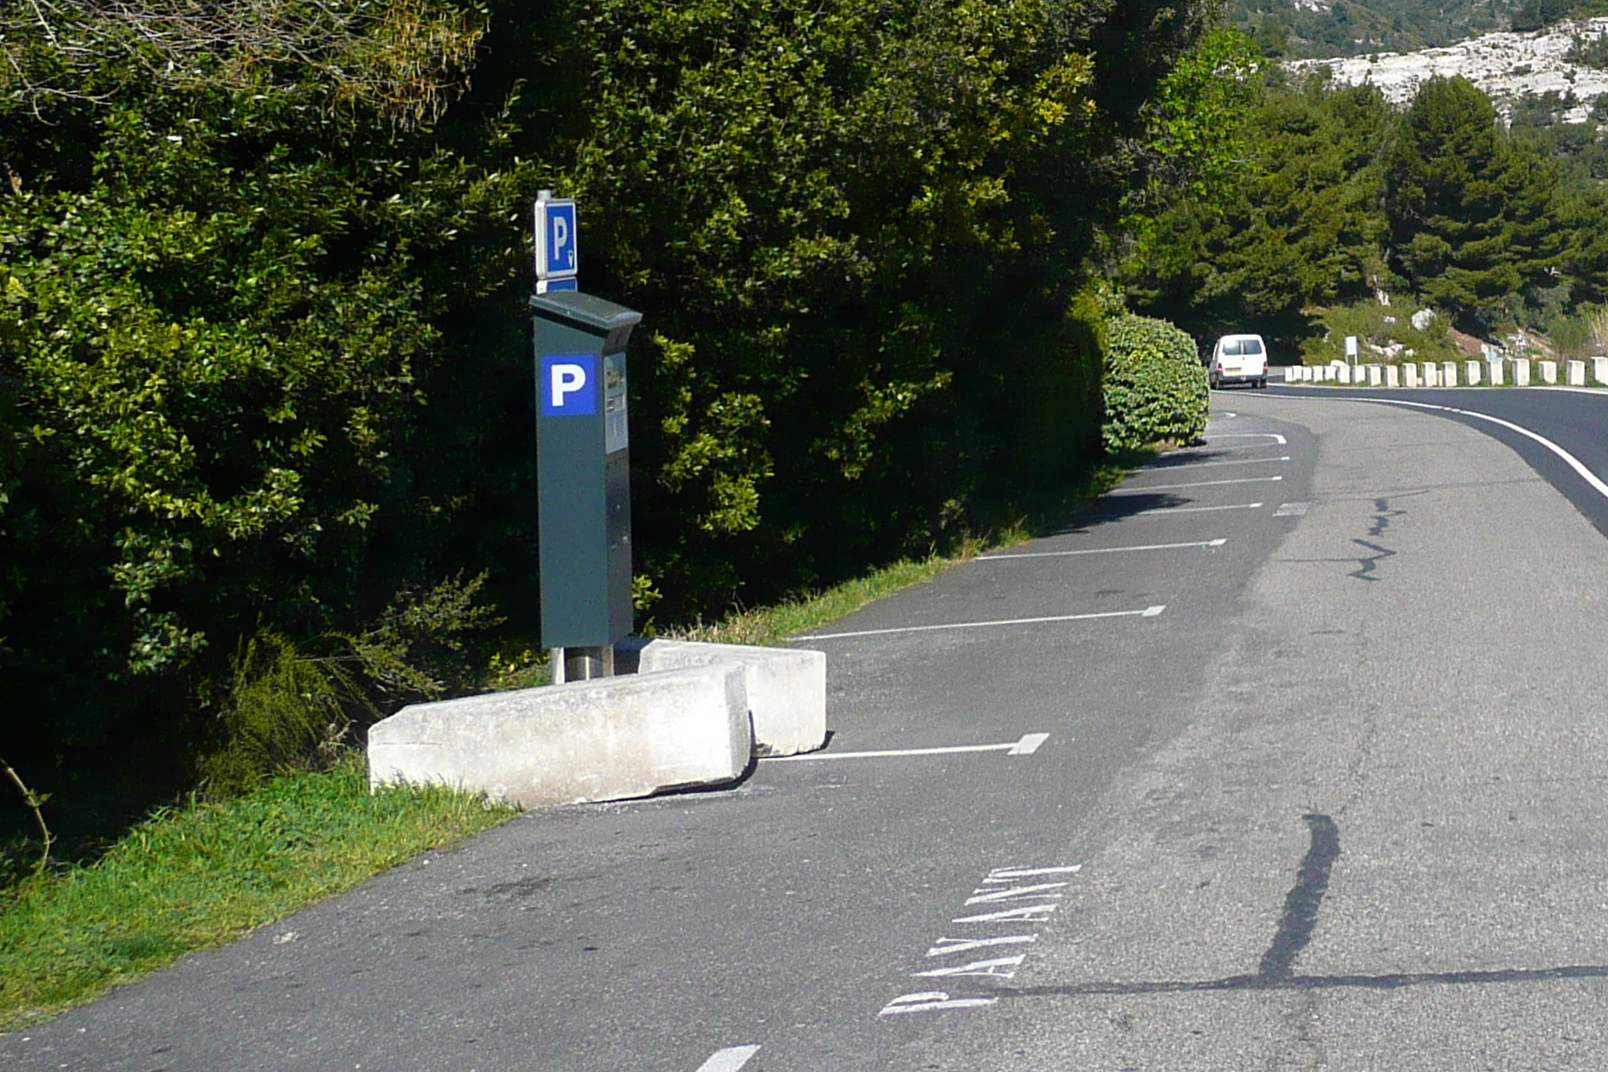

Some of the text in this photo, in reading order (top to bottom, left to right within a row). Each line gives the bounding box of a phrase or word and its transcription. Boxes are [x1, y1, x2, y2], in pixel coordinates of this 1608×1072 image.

[553, 216, 568, 260] P
[551, 364, 586, 407] P
[878, 864, 1082, 1016] PAYANT
